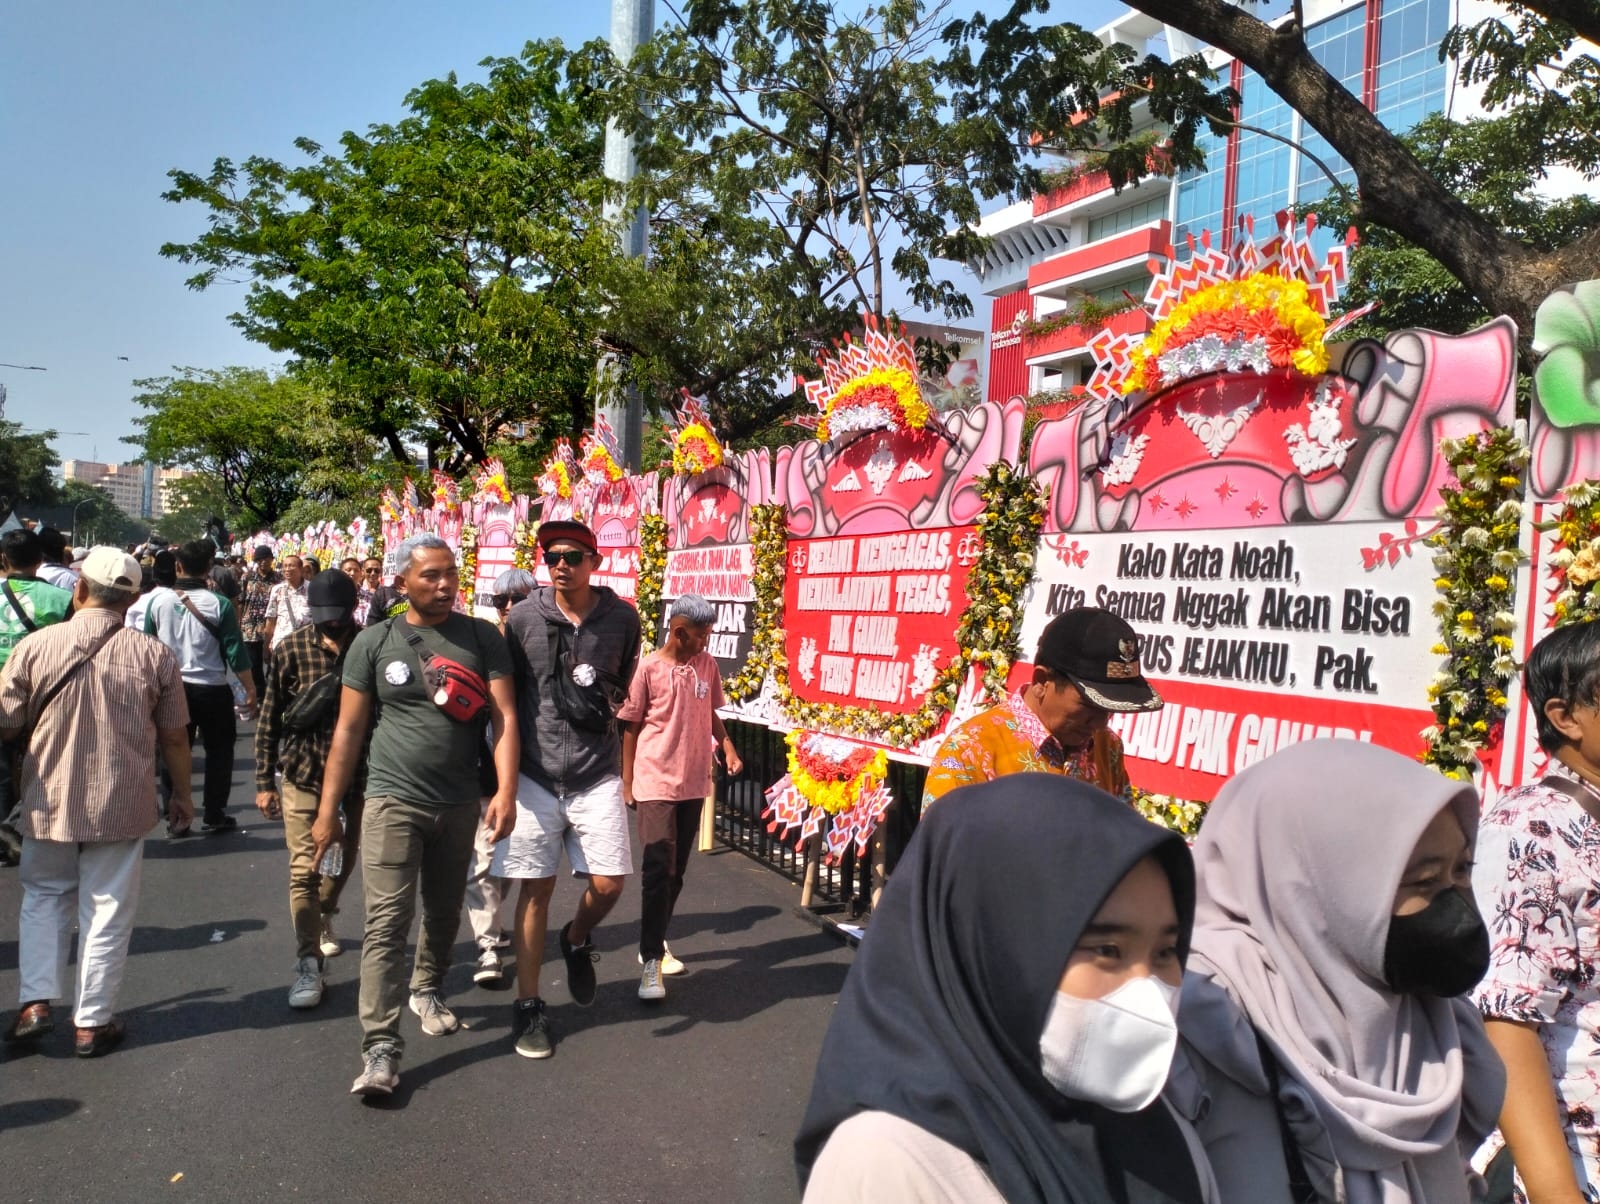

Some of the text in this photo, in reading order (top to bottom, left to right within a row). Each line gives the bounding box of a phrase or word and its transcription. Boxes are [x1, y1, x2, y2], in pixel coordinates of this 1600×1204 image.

[944, 332, 981, 345] Telkomsel
[807, 531, 953, 574] BERANI MENGGAGAS,
[1116, 540, 1300, 584] Kalo Kata Noah,
[895, 574, 952, 616] TEGAS,
[1045, 583, 1411, 634] Kita Semua Nggak Akan Bisa
[1178, 637, 1297, 686] JEJAKMU,
[1313, 645, 1378, 692] Pak.
[1175, 706, 1237, 776] PAK
